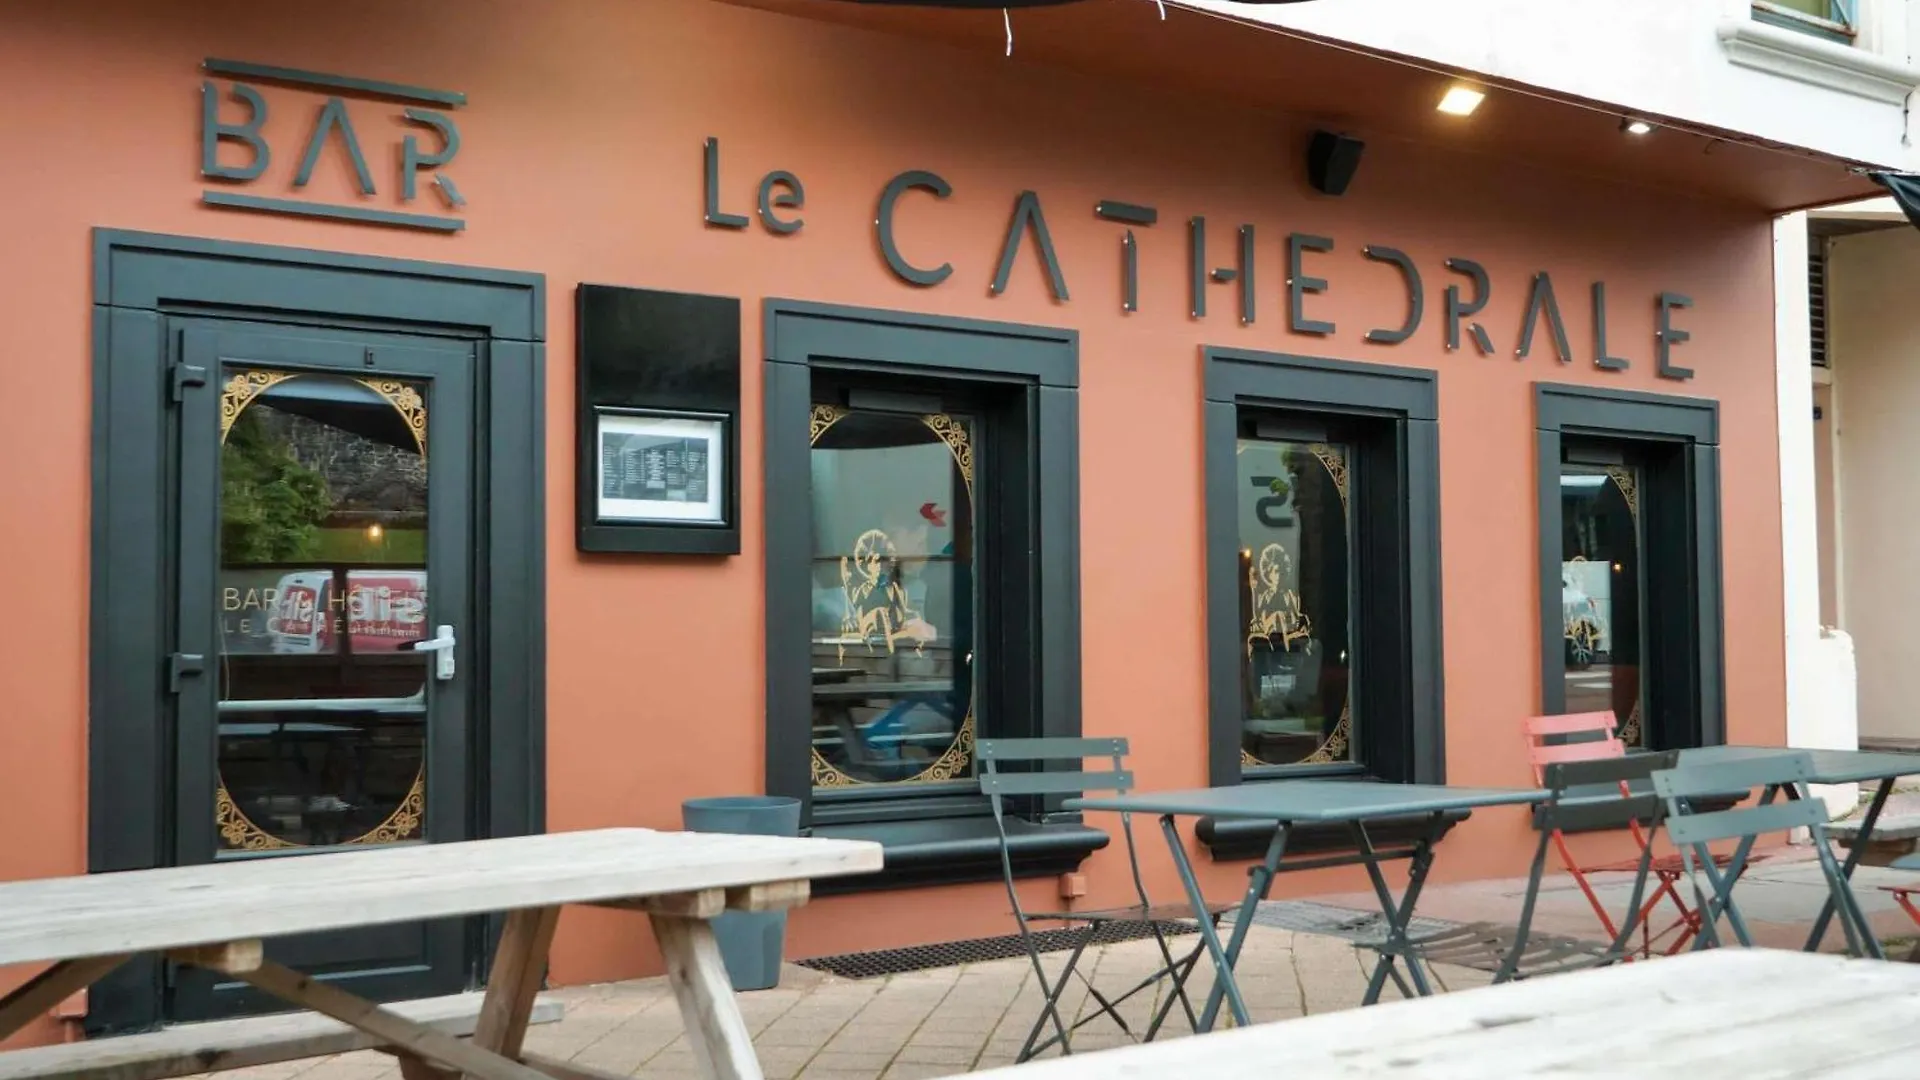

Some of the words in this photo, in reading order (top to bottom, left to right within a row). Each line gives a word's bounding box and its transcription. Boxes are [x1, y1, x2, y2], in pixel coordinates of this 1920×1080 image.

[201, 80, 466, 207] BAR
[705, 136, 804, 234] Le
[876, 169, 1694, 380] CATHEDRALE
[223, 587, 280, 612] BAR
